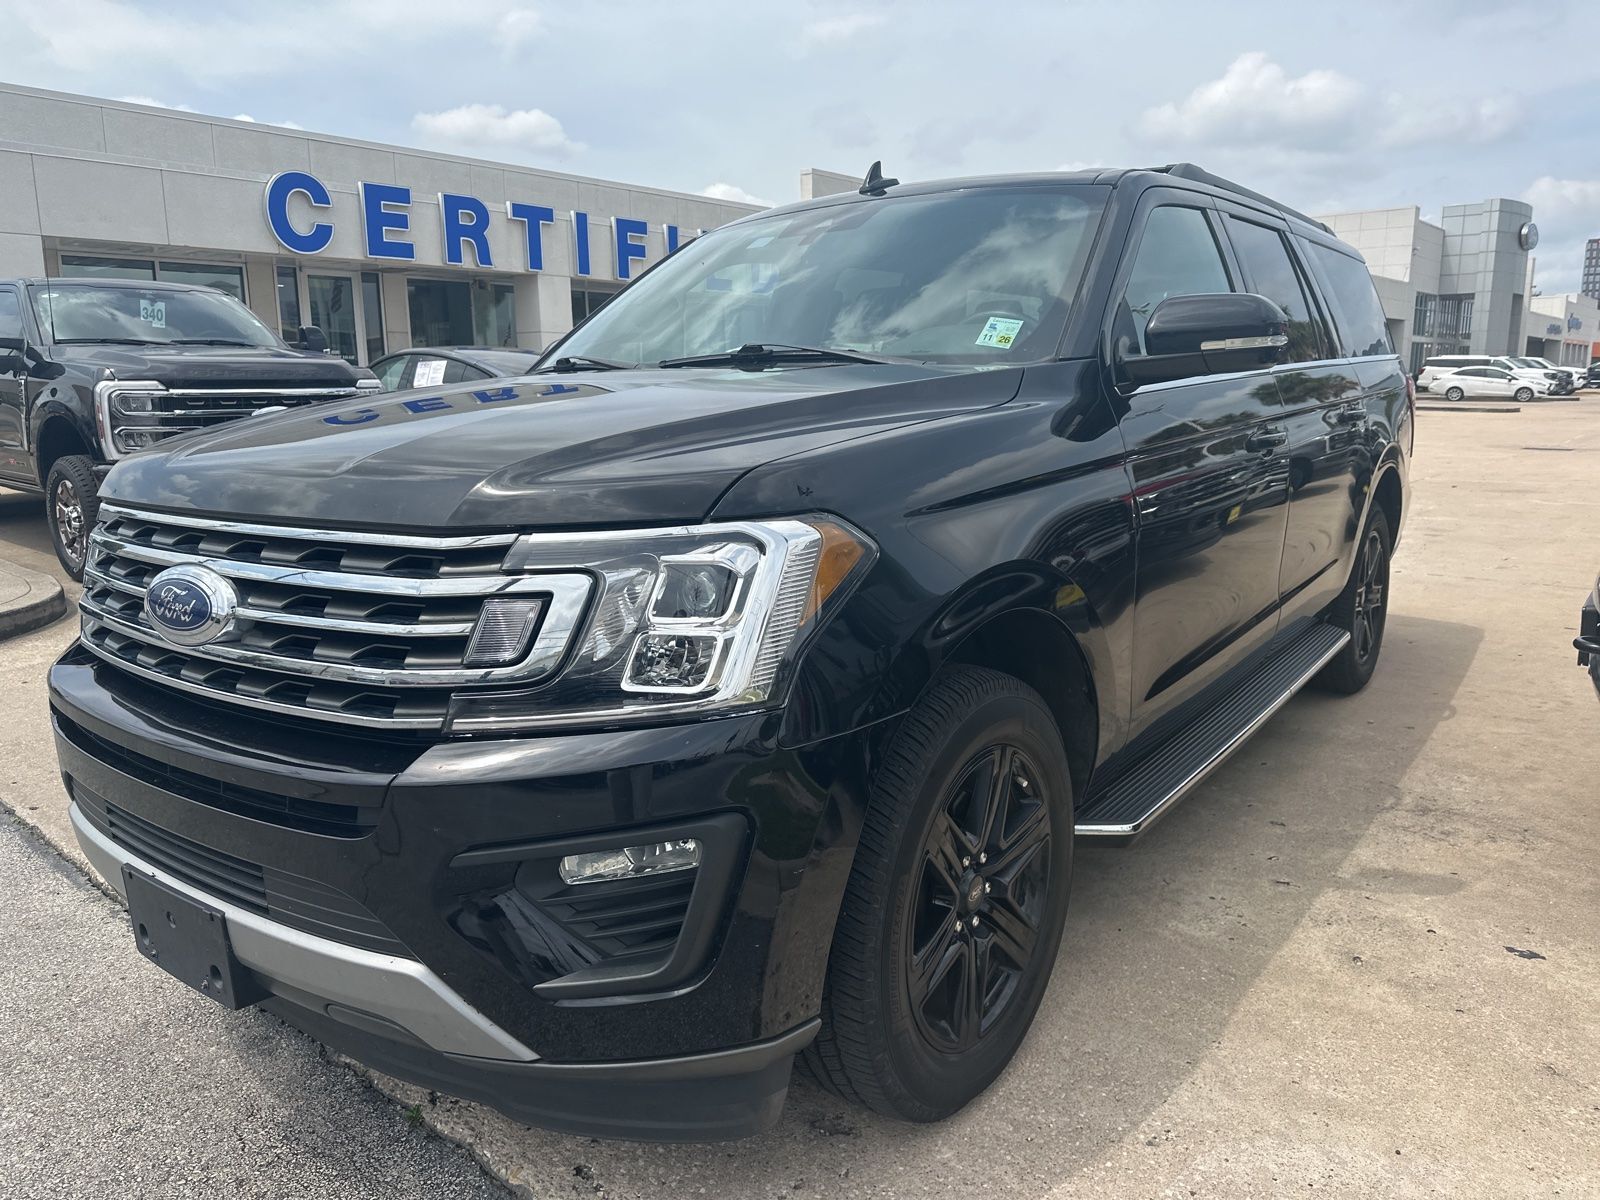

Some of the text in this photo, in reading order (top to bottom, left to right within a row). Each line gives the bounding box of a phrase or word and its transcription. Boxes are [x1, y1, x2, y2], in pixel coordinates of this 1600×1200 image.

[265, 171, 706, 280] CERTIFI
[142, 306, 164, 322] 340
[983, 334, 1012, 344] 11 26
[155, 585, 198, 623] Ford
